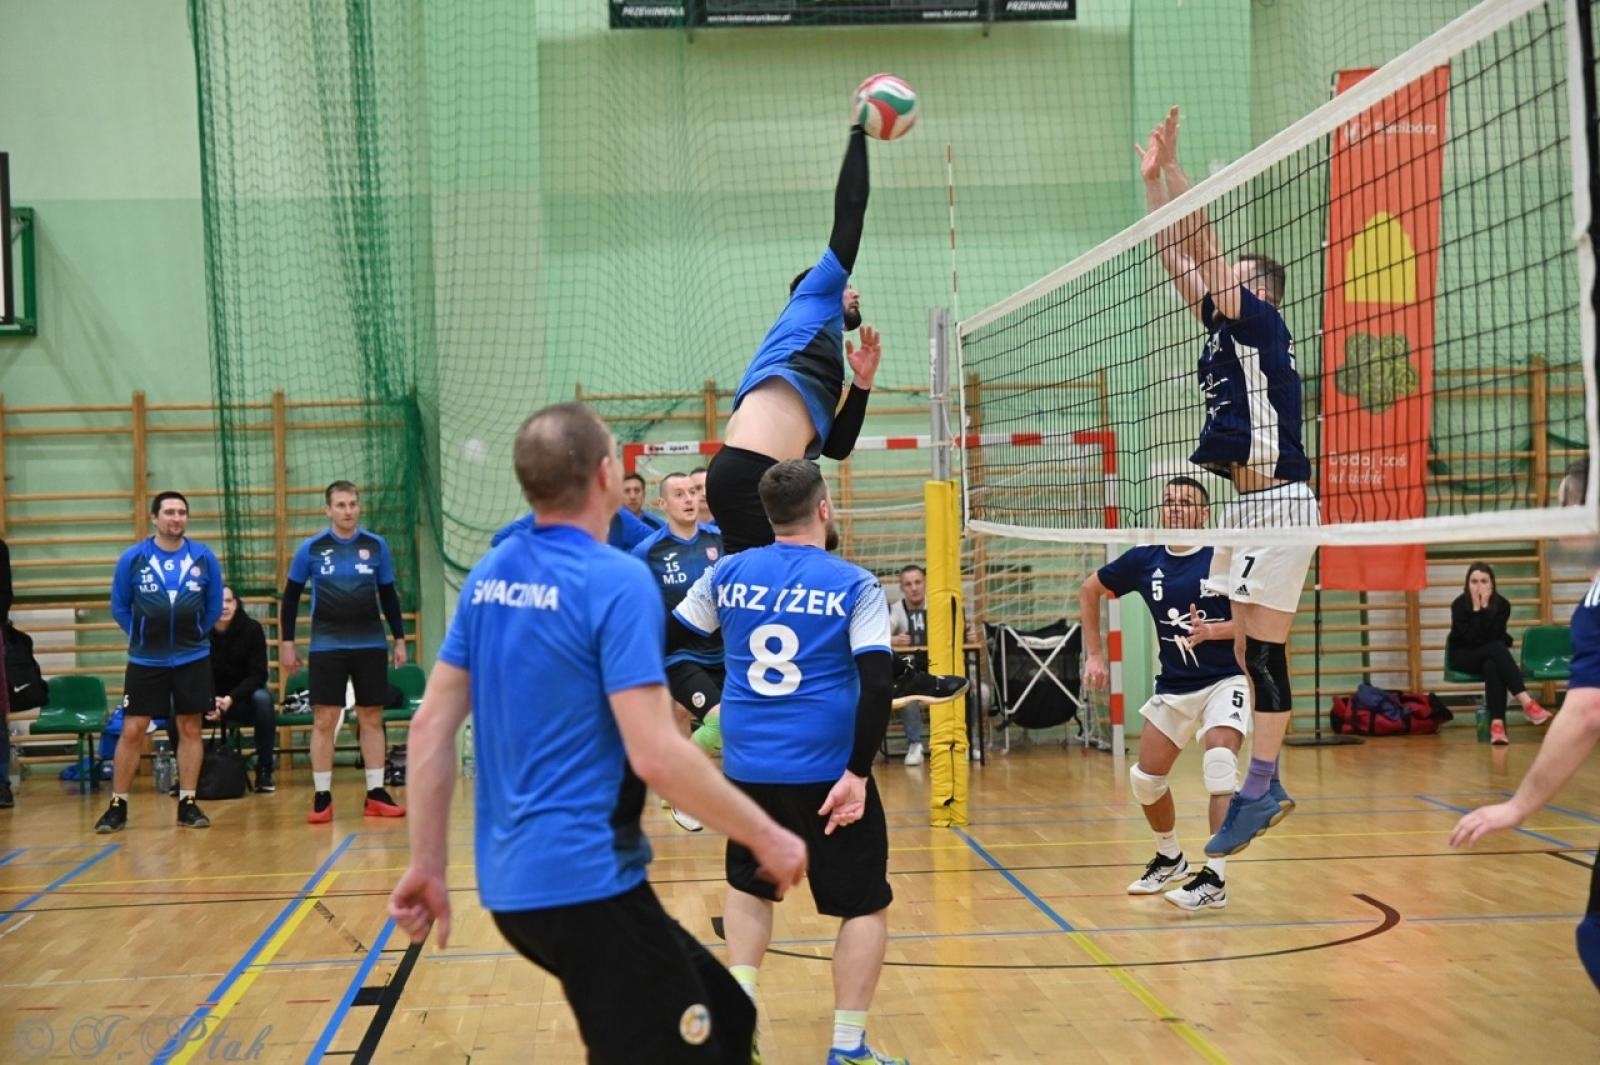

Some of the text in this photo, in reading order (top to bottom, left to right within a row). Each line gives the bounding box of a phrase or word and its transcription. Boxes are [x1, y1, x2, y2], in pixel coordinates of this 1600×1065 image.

[1006, 1, 1069, 11] PRZEWINIENIA
[163, 559, 175, 571] 6
[665, 561, 680, 573] 15
[1241, 556, 1255, 578] 7
[662, 572, 687, 585] M.D
[1152, 580, 1163, 601] 5
[909, 612, 925, 631] 14
[746, 624, 802, 696] 8
[1232, 690, 1244, 709] 5
